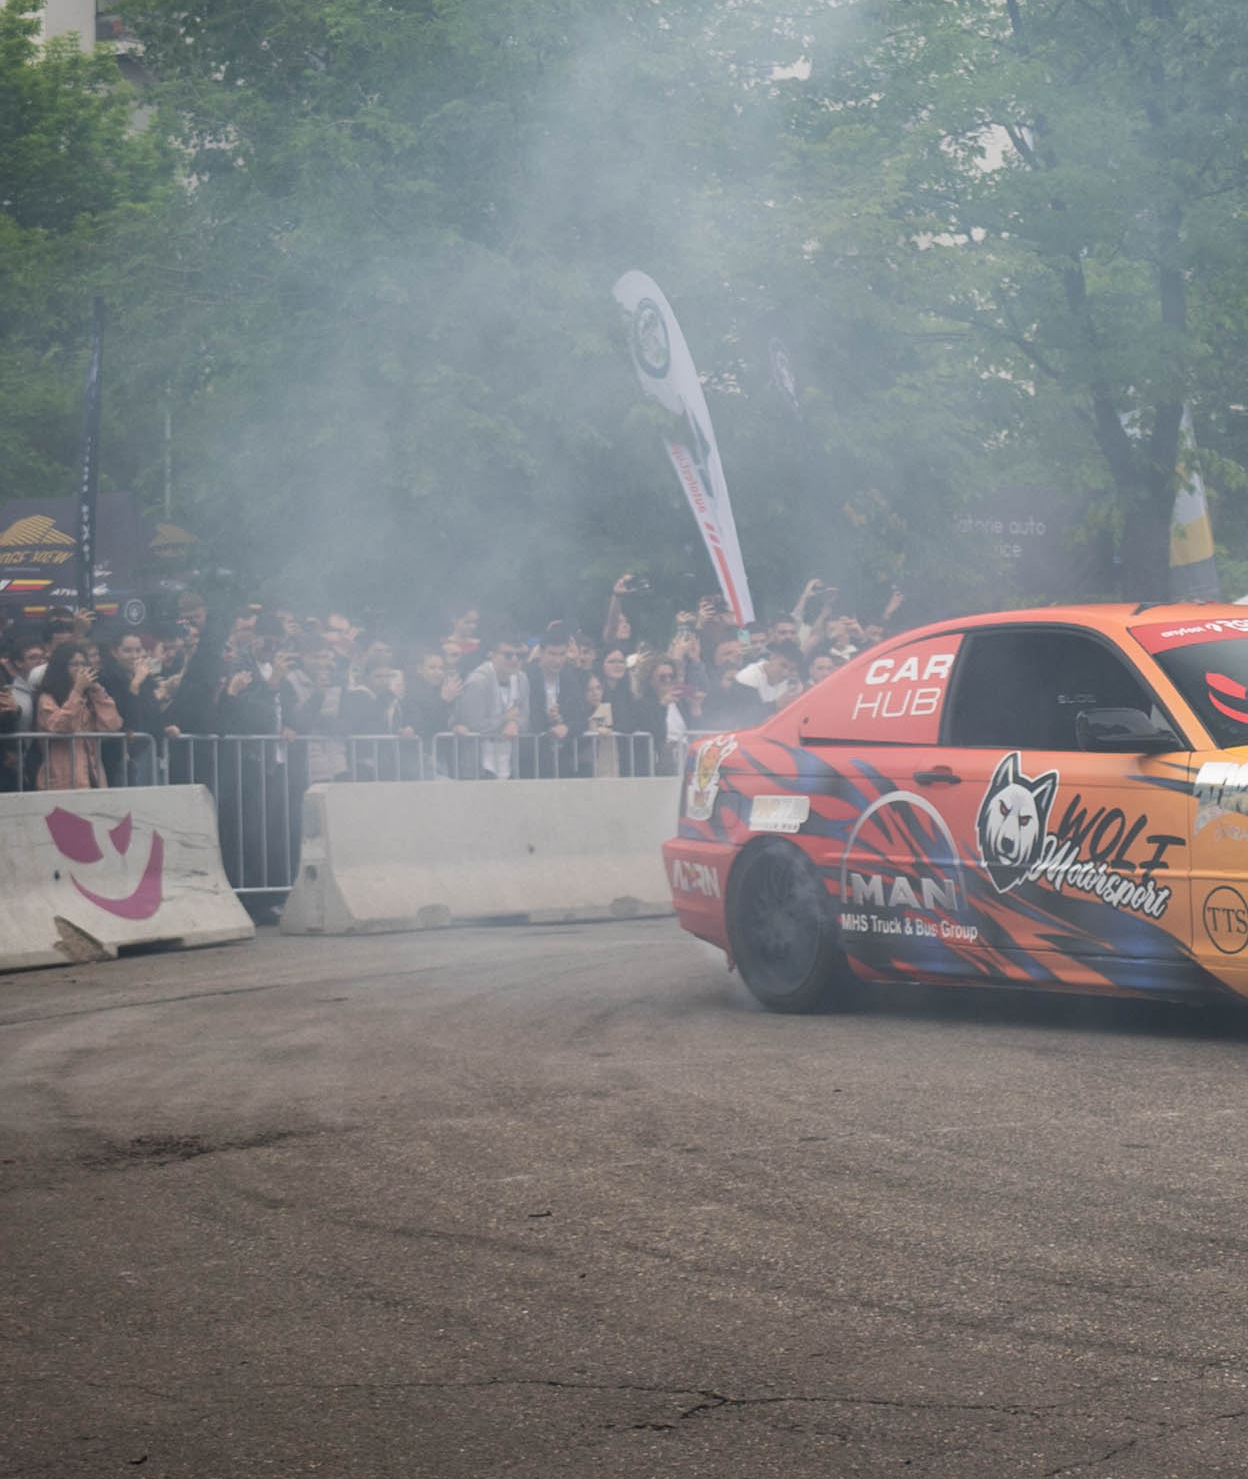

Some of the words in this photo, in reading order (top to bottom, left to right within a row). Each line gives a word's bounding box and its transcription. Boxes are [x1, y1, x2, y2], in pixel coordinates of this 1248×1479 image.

[1008, 514, 1047, 536] auto
[864, 653, 955, 686] CAR
[851, 687, 942, 720] HUB
[849, 872, 959, 912] MAN
[1027, 833, 1172, 919] Motorsport
[840, 912, 869, 932] MHS
[870, 914, 903, 934] Truck
[904, 918, 914, 936] &
[915, 918, 938, 938] Bus
[939, 920, 979, 943] Group
